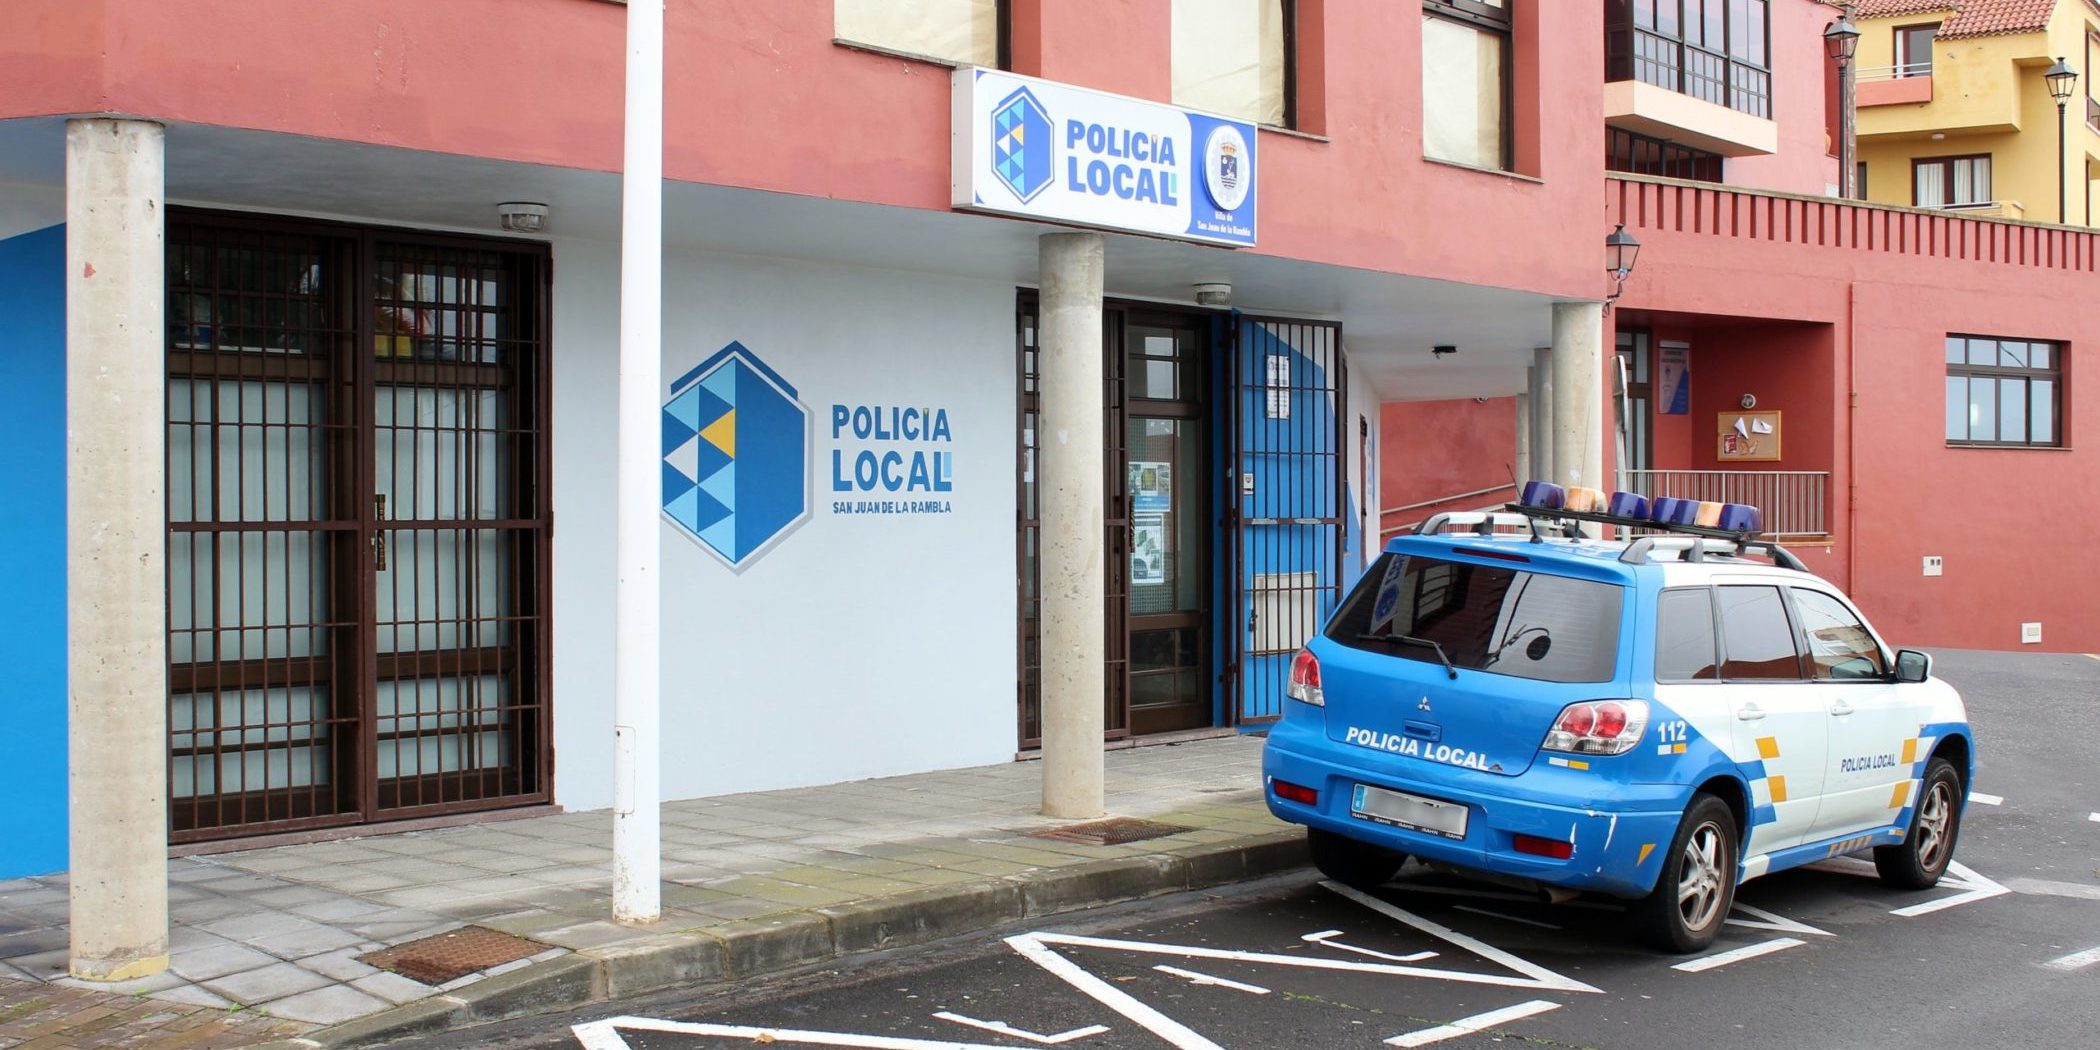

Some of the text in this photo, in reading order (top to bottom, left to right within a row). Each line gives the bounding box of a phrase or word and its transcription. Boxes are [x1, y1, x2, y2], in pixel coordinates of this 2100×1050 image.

[1068, 155, 1177, 206] LOCAL
[832, 449, 952, 492] LOCAL
[833, 501, 952, 514] SAN JUAN DE LA RAMBLA
[1657, 720, 1687, 743] 112
[1346, 726, 1490, 771] POLICIA LOCAL
[1840, 753, 1896, 773] POLICIA LOCAL
